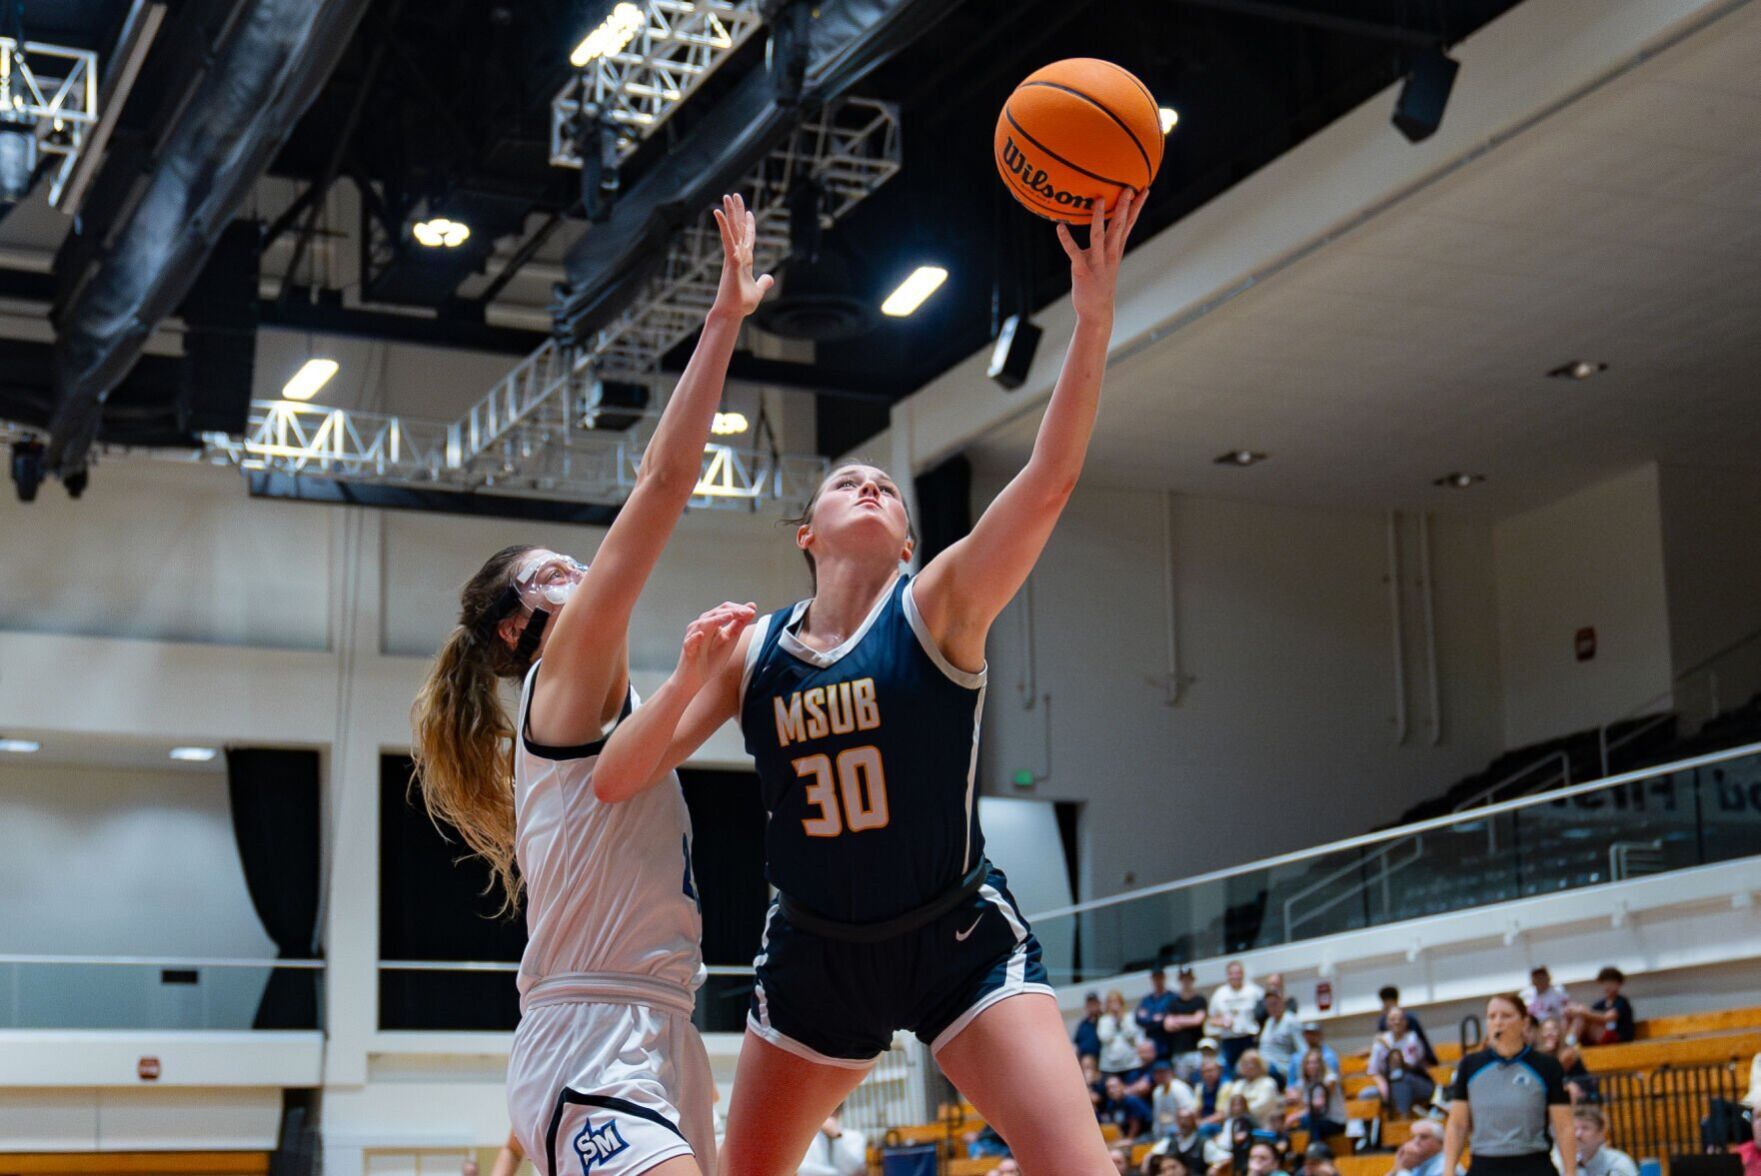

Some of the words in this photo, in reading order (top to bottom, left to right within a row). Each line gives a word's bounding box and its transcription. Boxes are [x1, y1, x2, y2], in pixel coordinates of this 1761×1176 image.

[1003, 136, 1094, 211] Wilson
[773, 677, 881, 748] MSUB
[790, 745, 890, 838] 30
[574, 1121, 626, 1168] SM
